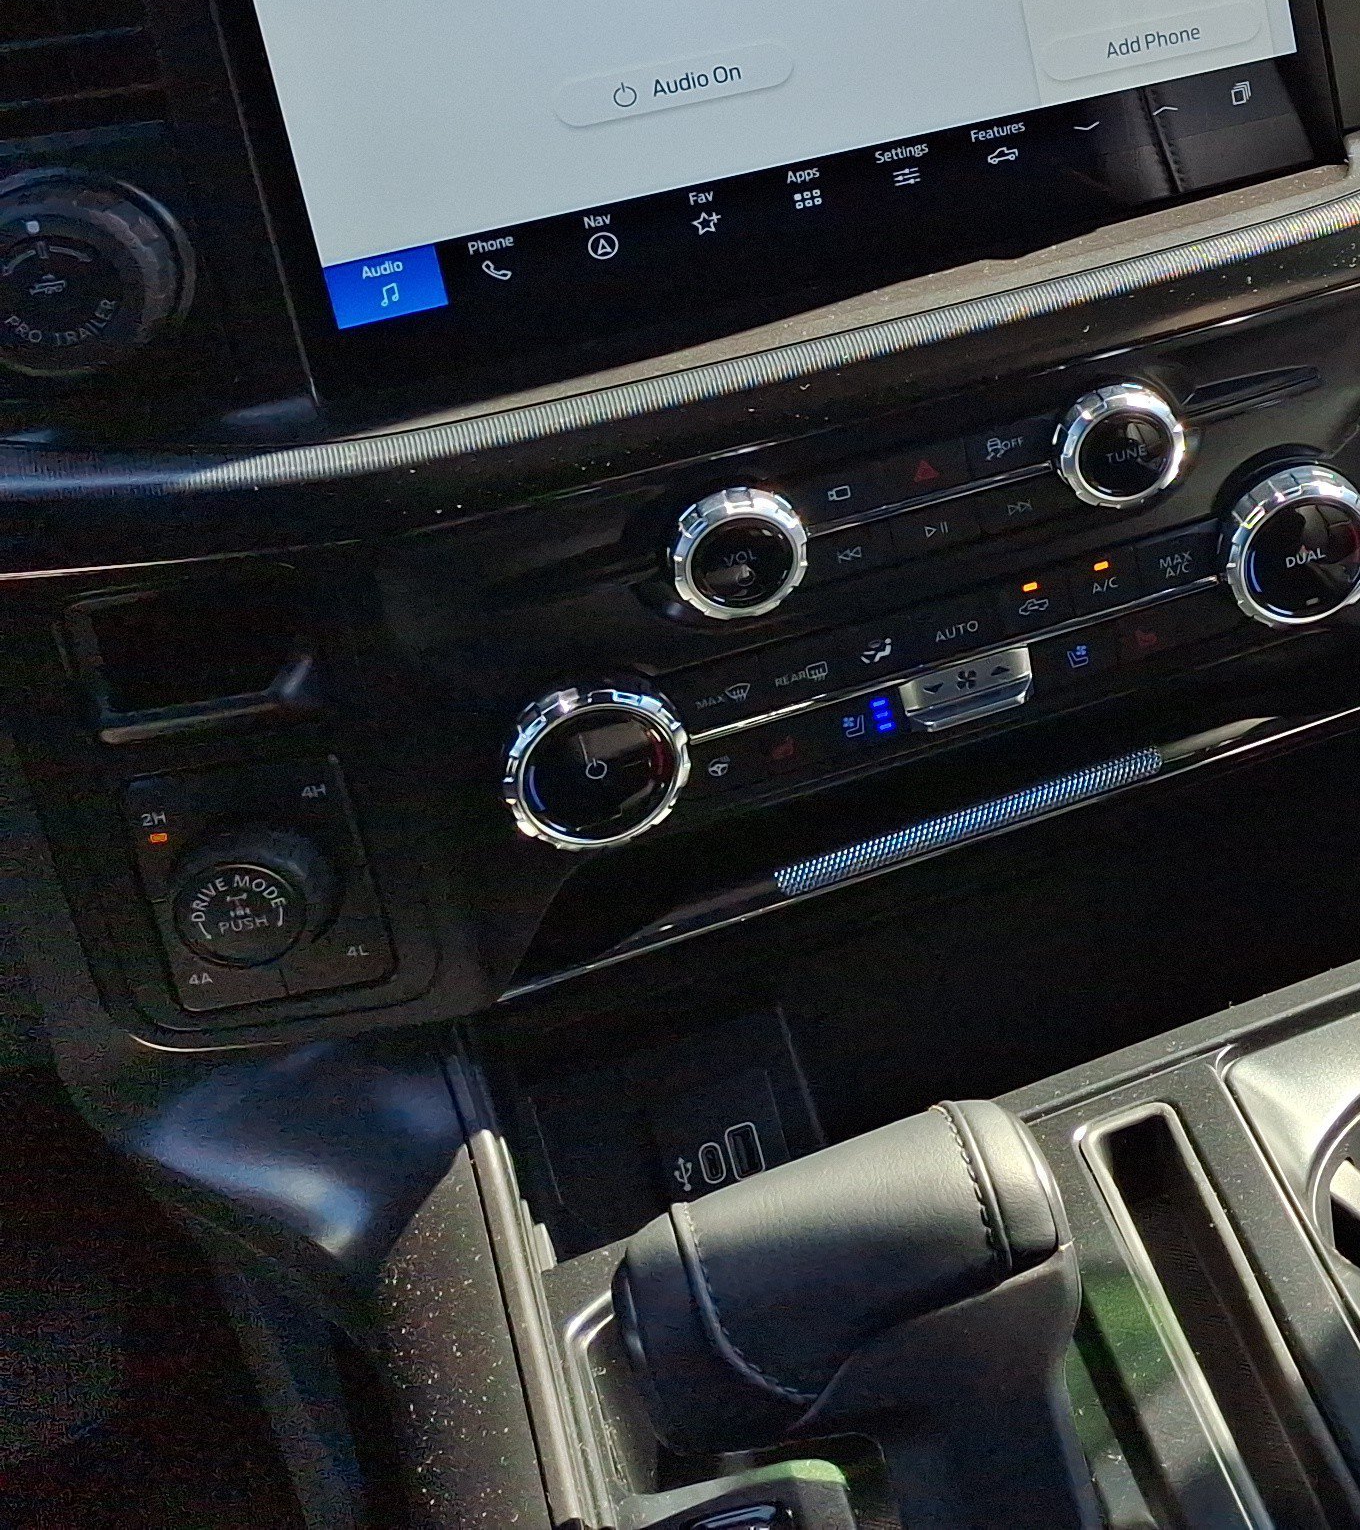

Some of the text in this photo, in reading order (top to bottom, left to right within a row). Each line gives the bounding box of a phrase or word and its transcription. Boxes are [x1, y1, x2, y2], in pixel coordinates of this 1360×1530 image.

[1106, 26, 1201, 58] Add Phone
[652, 64, 742, 98] Audio On
[361, 120, 1026, 280] Audio Phone Nav Fav Apps Settings Features
[6, 315, 43, 343] PRO
[1001, 436, 1024, 452] OFF
[1106, 444, 1149, 464] TUNE
[723, 549, 757, 567] VOL
[1159, 551, 1193, 570] MAX
[1285, 547, 1326, 569] DUAL
[1165, 560, 1191, 580] A/C
[1092, 576, 1119, 595] A/C
[935, 620, 979, 643] AUTO
[775, 670, 806, 688] REAR
[301, 783, 326, 798] 4H
[140, 811, 167, 827] 2H
[191, 874, 287, 923] DRIVE MODE
[218, 915, 268, 935] PUSH
[347, 944, 370, 958] 4L
[188, 972, 214, 986] 4A
